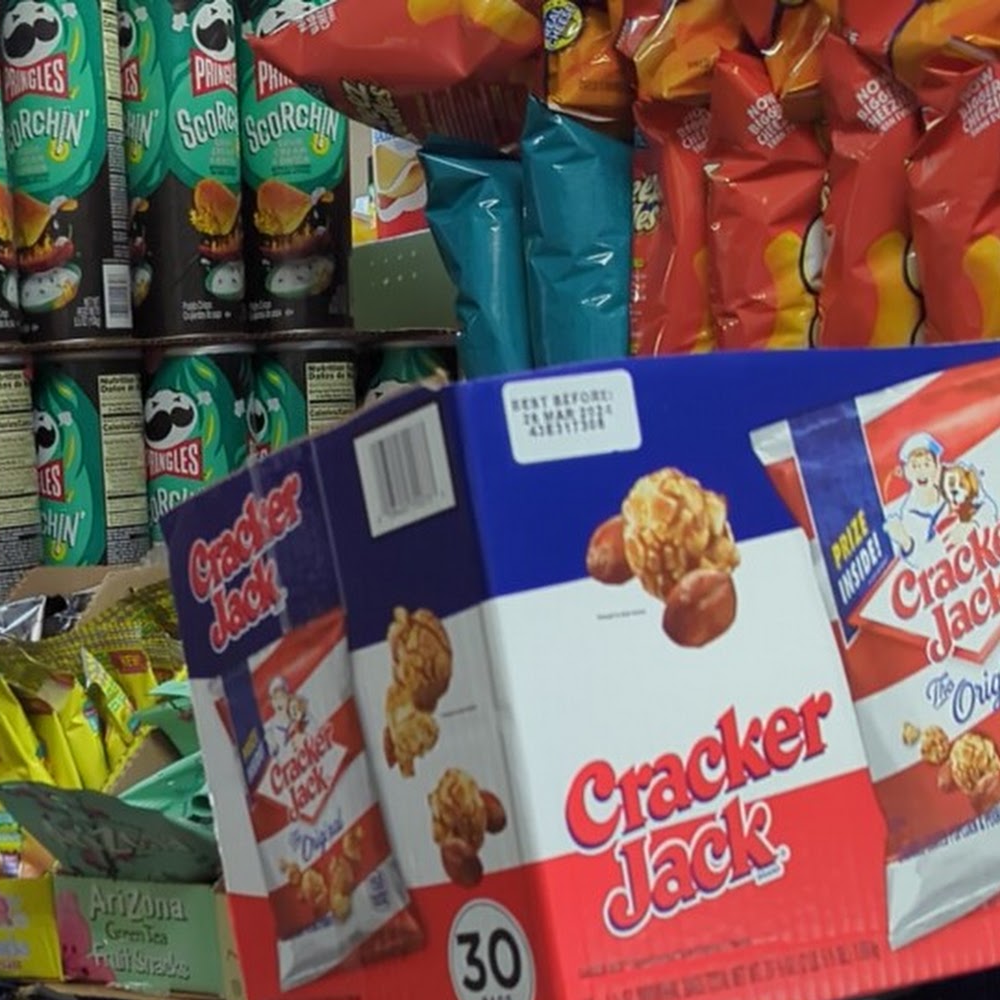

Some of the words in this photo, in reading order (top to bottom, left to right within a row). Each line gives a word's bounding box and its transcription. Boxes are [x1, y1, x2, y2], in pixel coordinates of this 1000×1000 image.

[4, 58, 66, 101] PRINGLES
[245, 102, 340, 155] SCORCHIN
[189, 472, 301, 603] Cracker
[830, 509, 869, 570] PRIZE
[838, 533, 882, 605] INSIDE!
[210, 559, 278, 653] Jack
[926, 672, 954, 710] The
[270, 724, 334, 794] Cracker
[565, 690, 833, 852] Cracker
[287, 768, 331, 822] Jack
[604, 795, 776, 937] Jack
[89, 887, 188, 923] AriZona
[105, 923, 142, 944] Green
[144, 923, 168, 945] Tea
[91, 946, 126, 975] Fruit
[127, 953, 191, 980] Snacks
[456, 926, 523, 994] 30
